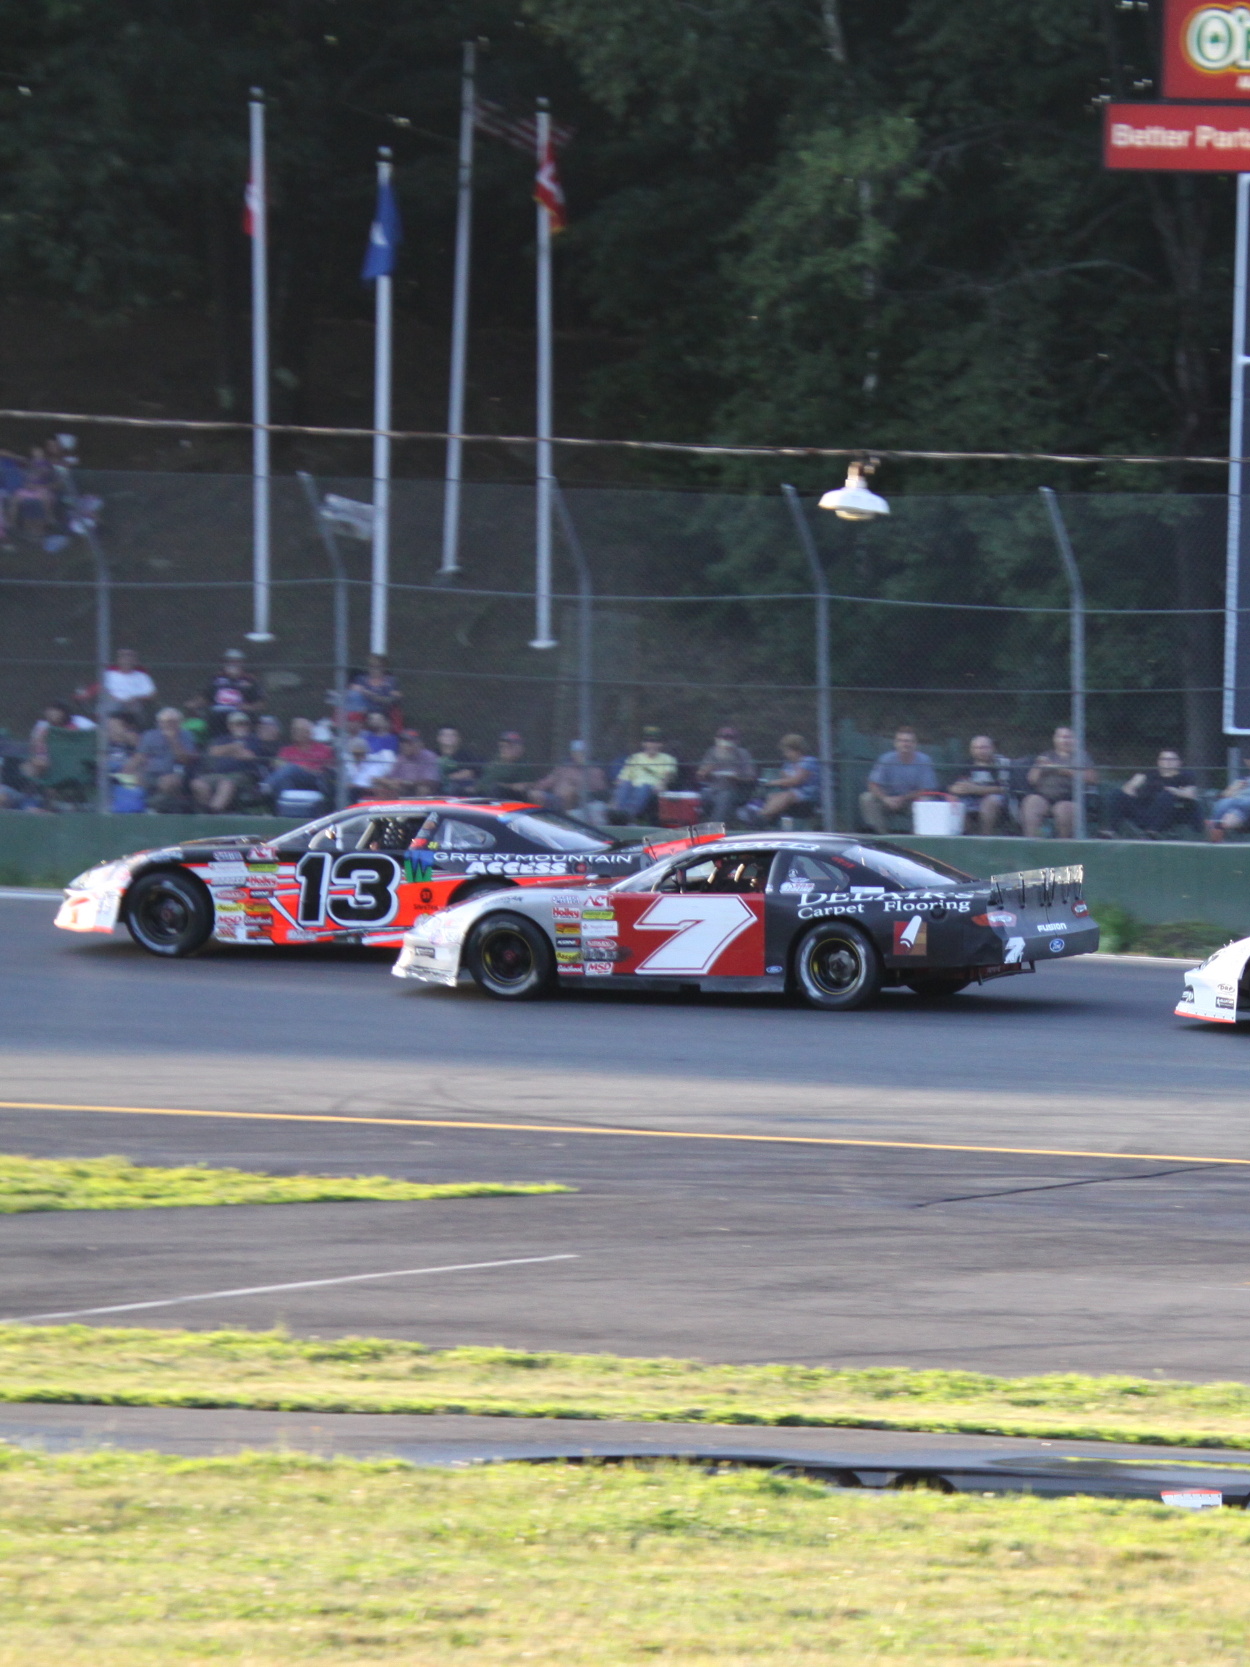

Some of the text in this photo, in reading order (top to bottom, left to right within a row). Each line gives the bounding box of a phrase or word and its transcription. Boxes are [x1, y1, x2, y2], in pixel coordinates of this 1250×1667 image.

[1111, 123, 1192, 148] Better
[433, 852, 632, 864] GREEN MOUNTAIN
[465, 861, 567, 875] ACCESS
[296, 852, 401, 927] 13
[797, 899, 970, 919] Carpet Flooring
[633, 894, 758, 974] 7
